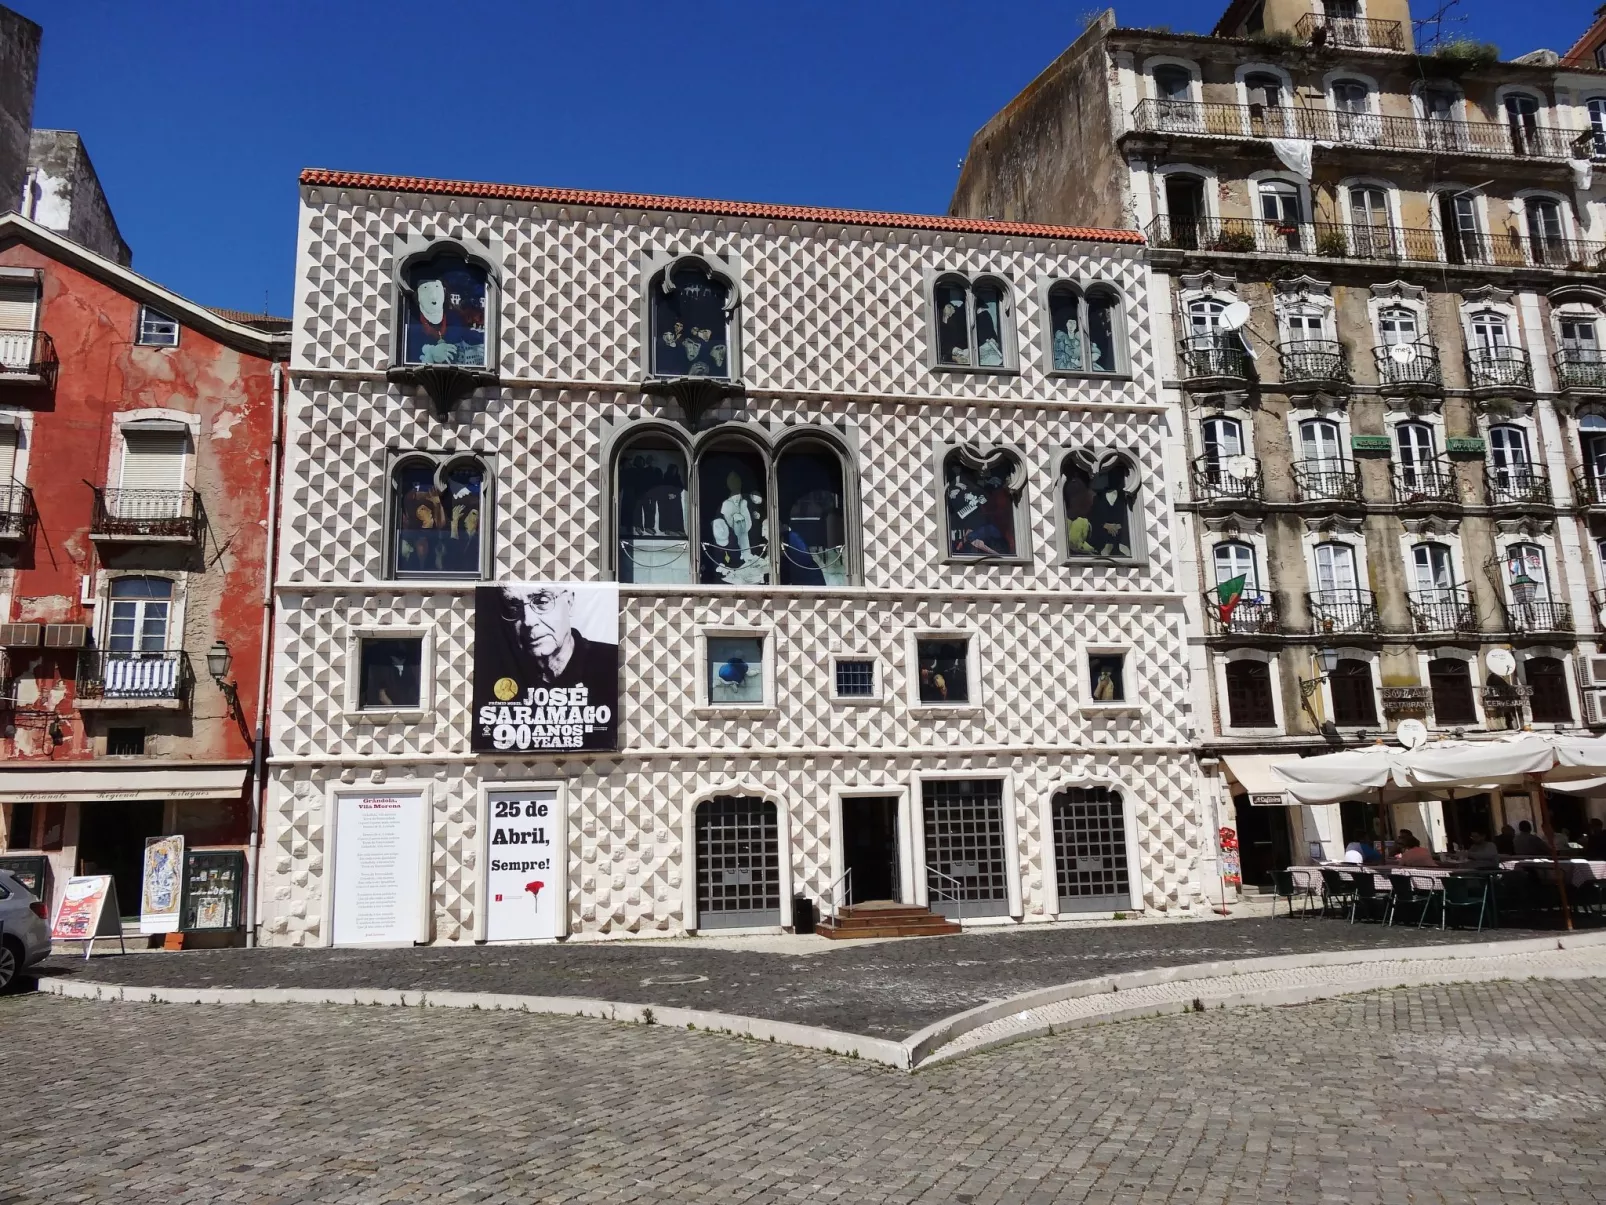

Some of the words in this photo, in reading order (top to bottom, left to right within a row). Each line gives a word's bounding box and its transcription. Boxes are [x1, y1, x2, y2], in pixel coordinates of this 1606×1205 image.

[523, 682, 589, 707] JOSÉ
[479, 705, 612, 725] SARAMAGO
[493, 724, 532, 750] 90
[532, 724, 584, 737] ANOS
[532, 736, 584, 749] YEARS
[96, 790, 140, 800] Regional
[495, 801, 521, 818] 25
[525, 801, 549, 818] de
[492, 828, 550, 847] Abril,
[491, 858, 550, 873] Sempre!
